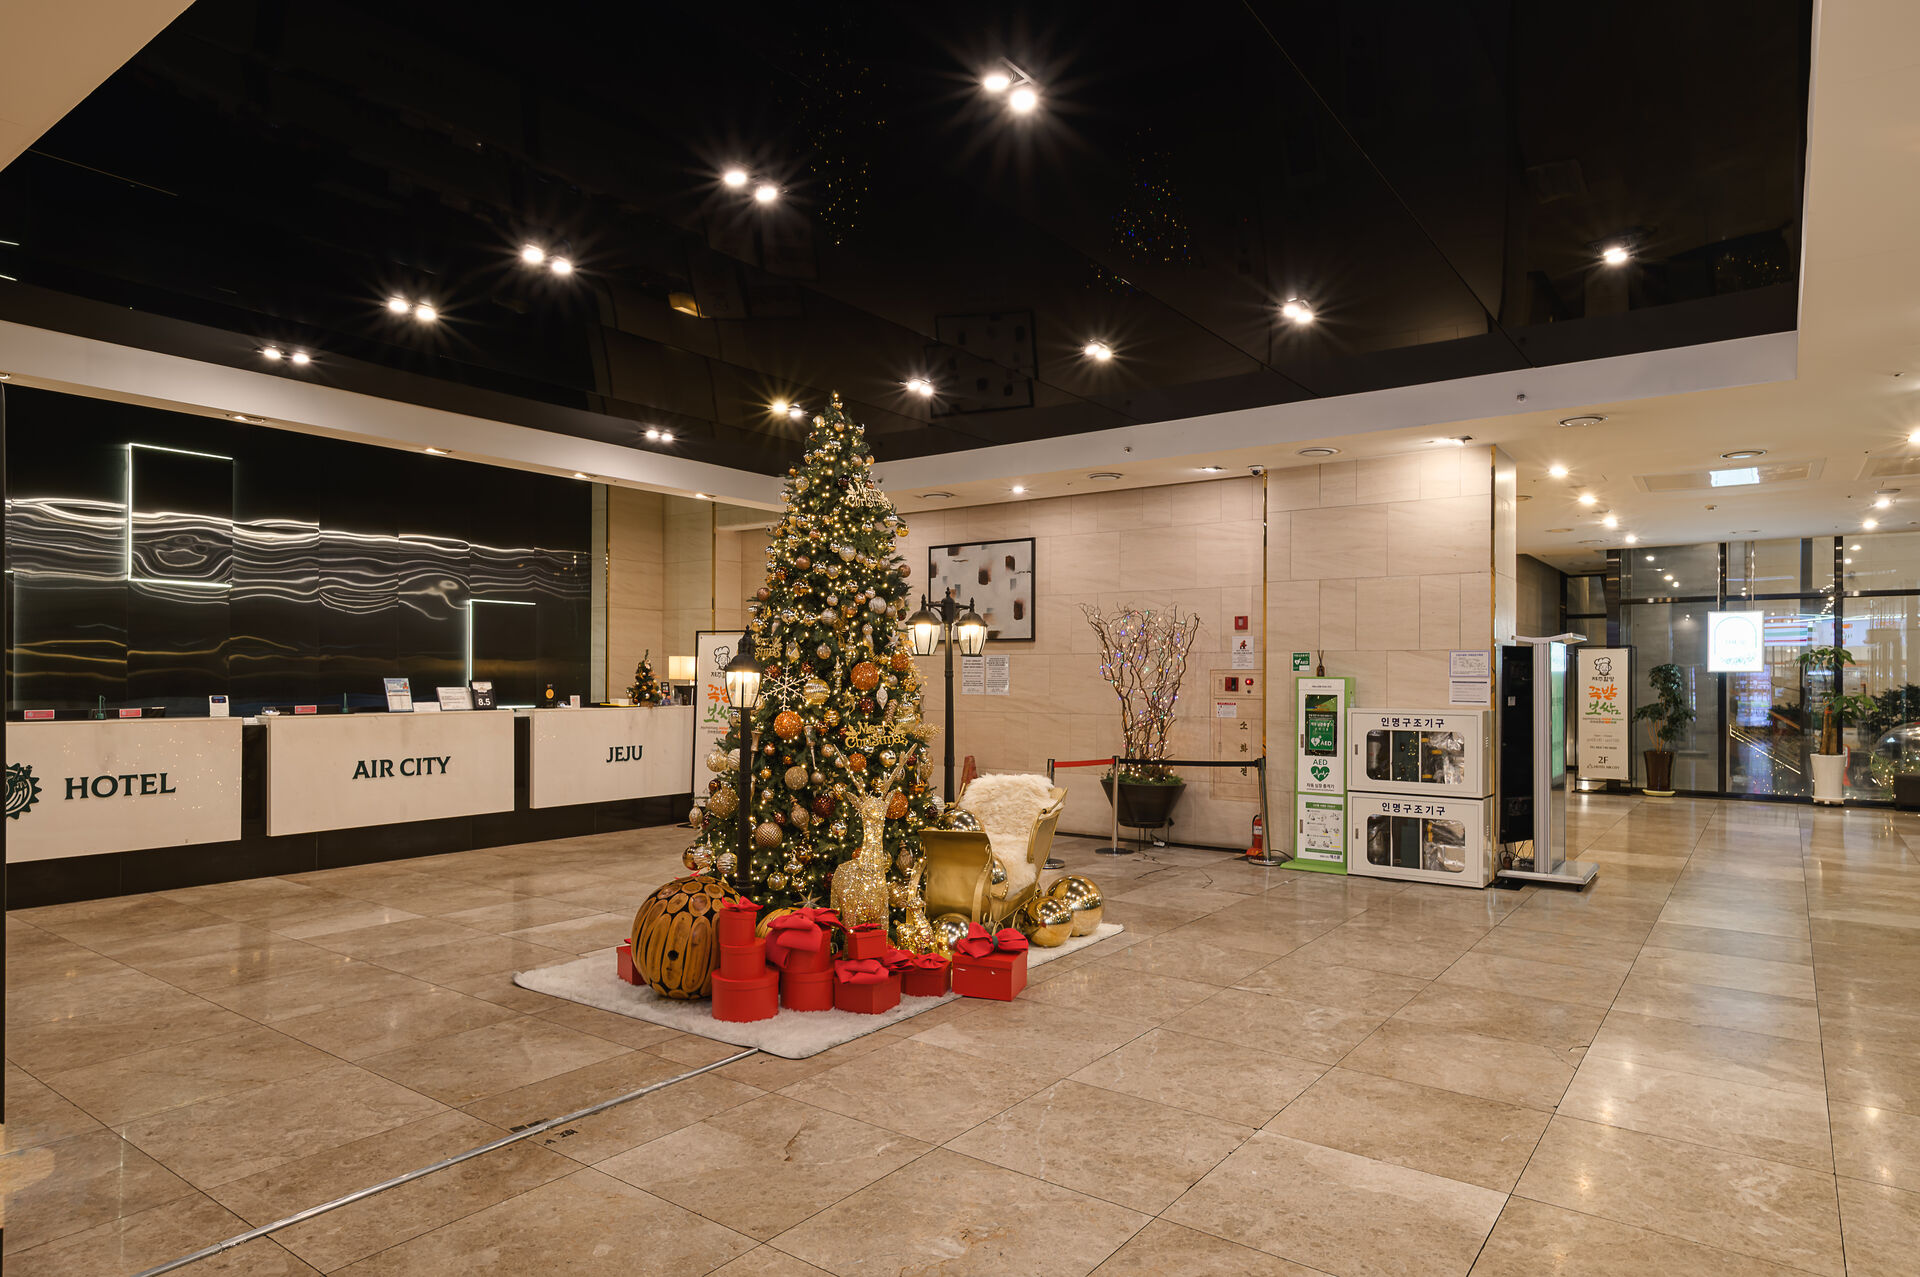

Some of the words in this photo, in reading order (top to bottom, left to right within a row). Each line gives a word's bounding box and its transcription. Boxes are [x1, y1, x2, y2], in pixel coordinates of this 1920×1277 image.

[1588, 683, 1618, 700] 족발
[478, 698, 491, 706] 8.5
[1585, 700, 1621, 715] 보쌈
[856, 720, 897, 736] Merry
[1380, 717, 1445, 729] 인명구조기구
[844, 734, 909, 748] Christmas
[606, 745, 644, 763] JEJU
[1598, 756, 1609, 764] 2F
[352, 759, 395, 780] AIR
[399, 756, 451, 777] CITY
[65, 772, 176, 800] HOTEL
[1381, 802, 1446, 816] 인명구조기구
